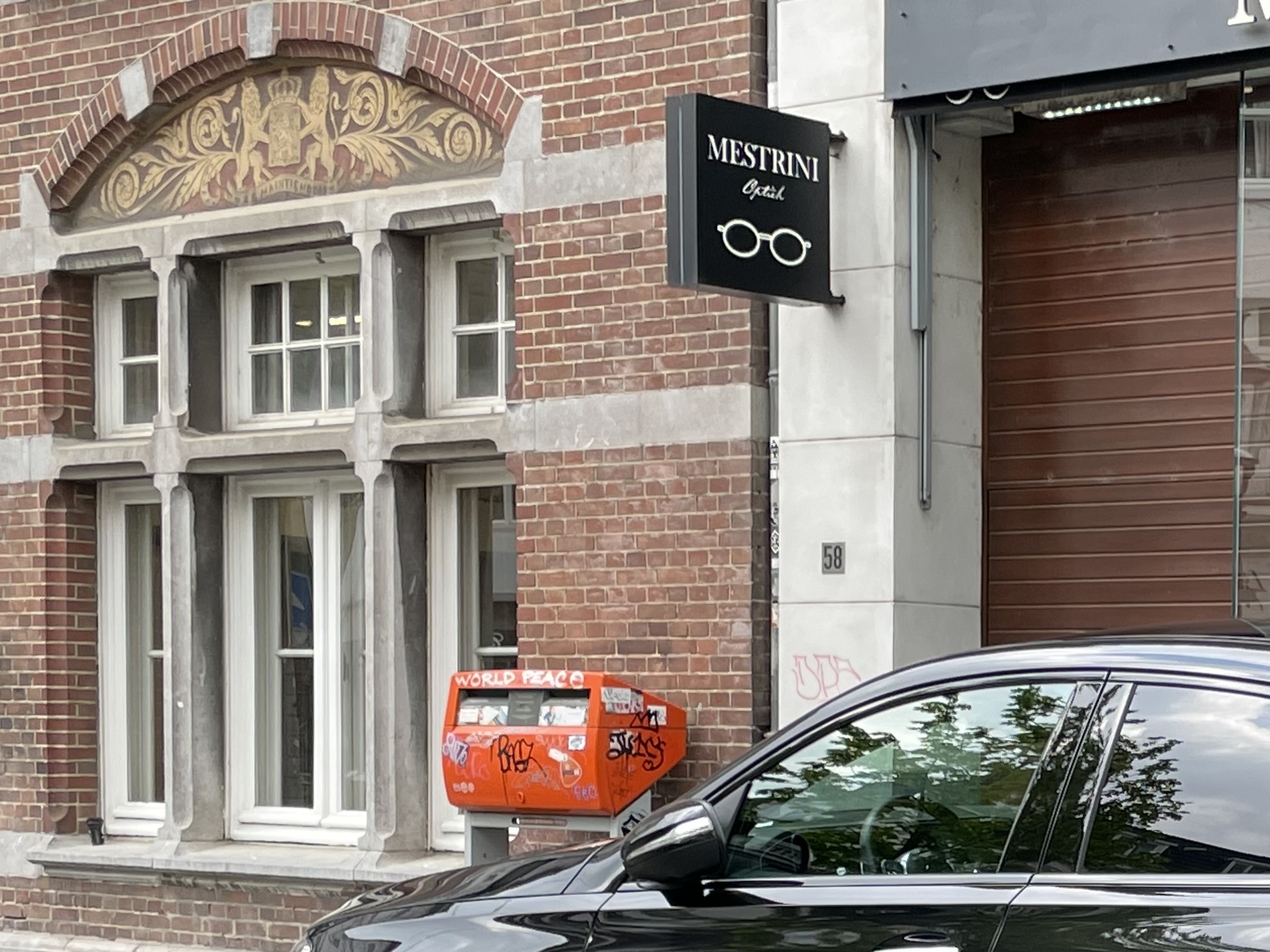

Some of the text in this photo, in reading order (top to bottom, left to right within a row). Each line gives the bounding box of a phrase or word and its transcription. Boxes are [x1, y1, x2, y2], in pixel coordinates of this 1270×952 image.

[707, 134, 820, 183] MESTRINI
[823, 545, 843, 570] 58
[455, 671, 516, 687] WORLD
